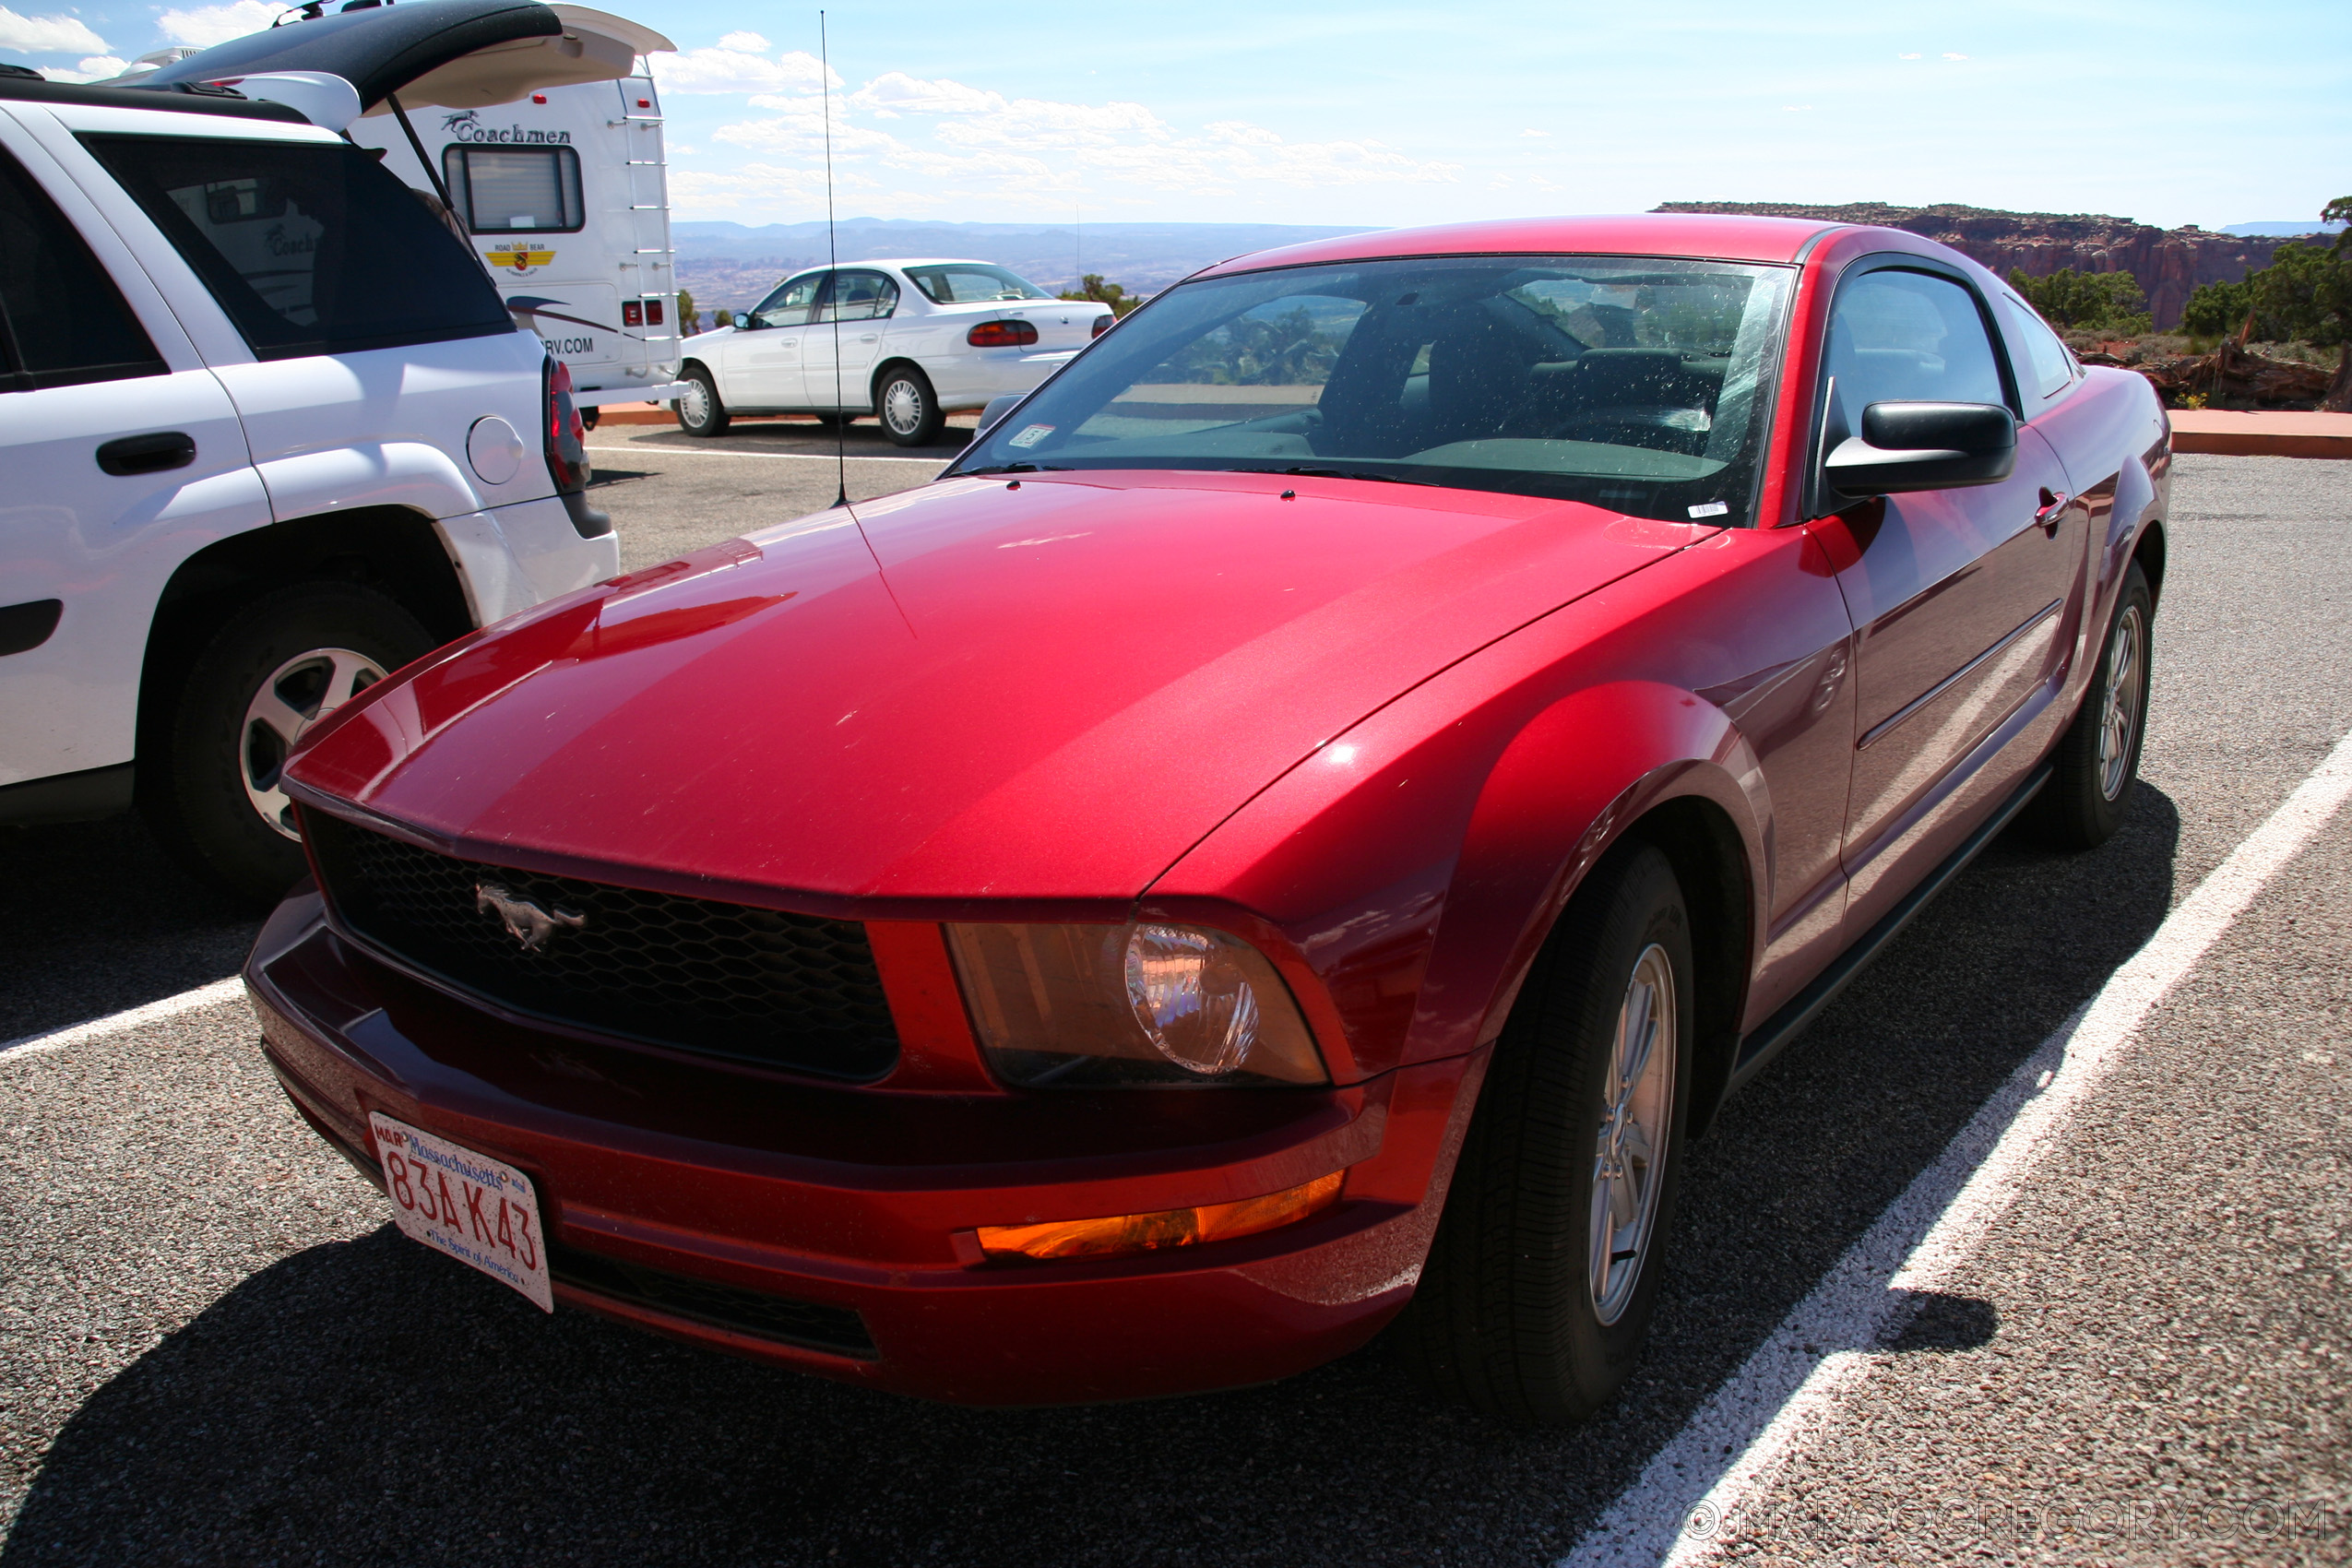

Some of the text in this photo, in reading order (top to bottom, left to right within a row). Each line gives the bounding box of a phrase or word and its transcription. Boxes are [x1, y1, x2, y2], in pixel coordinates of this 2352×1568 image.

[456, 123, 571, 144] Coachmen
[408, 1134, 504, 1191] Massachusetts
[430, 1229, 519, 1284] The Spirit of America
